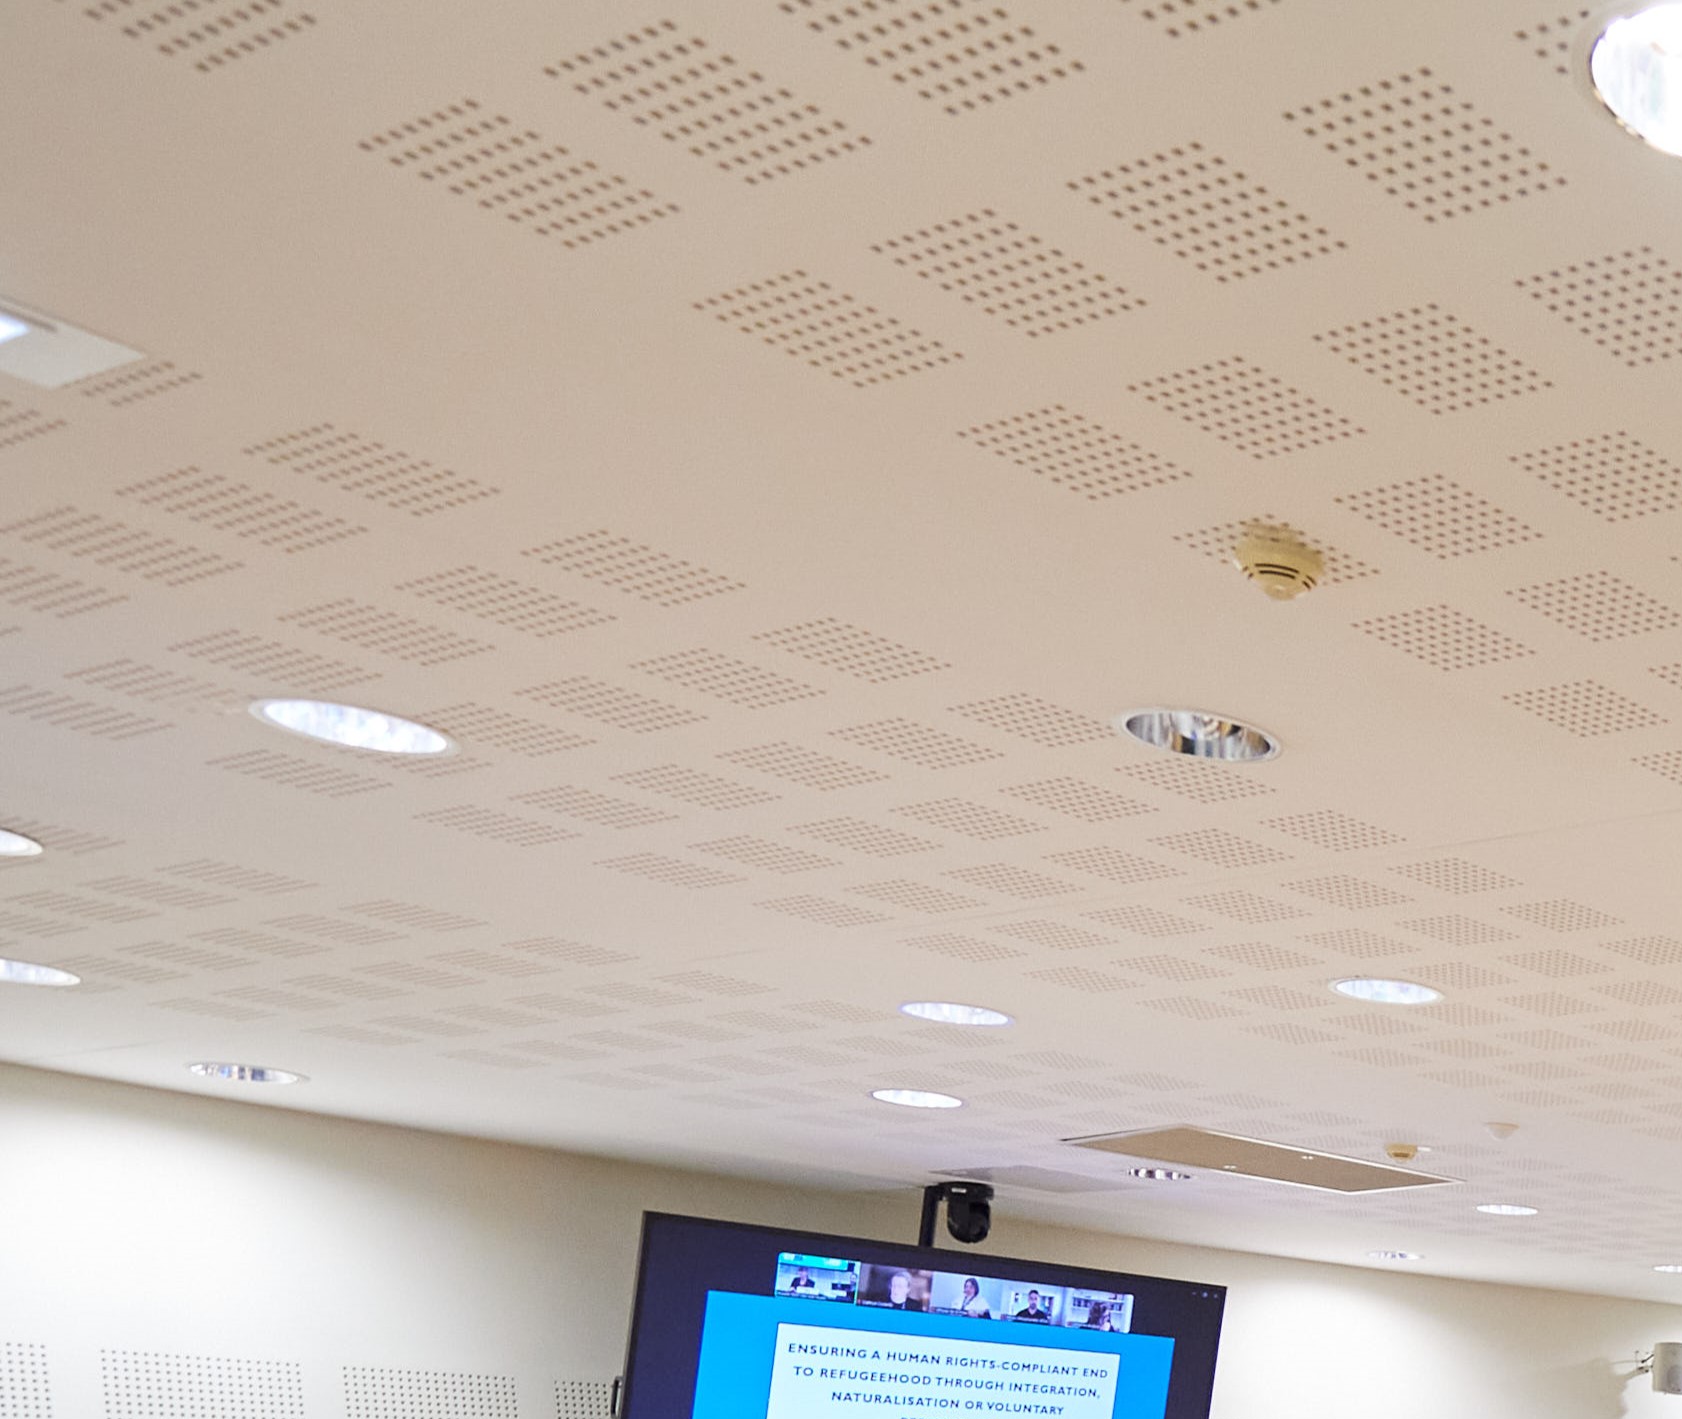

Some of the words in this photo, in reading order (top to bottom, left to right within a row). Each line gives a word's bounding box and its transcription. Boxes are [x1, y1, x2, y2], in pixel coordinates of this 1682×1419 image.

[788, 1343, 867, 1359] ENSURING
[871, 1350, 881, 1360] A
[886, 1351, 941, 1365] HUMAN
[945, 1356, 1079, 1376] RIGHTS-COMPLIANT
[1082, 1368, 1108, 1379] END
[793, 1366, 814, 1377] TO
[820, 1368, 932, 1385] REFUGEEHOOD
[935, 1377, 1005, 1391] THROUGH
[1008, 1382, 1101, 1399] INTEGRATION,
[831, 1391, 960, 1409] NATURALISATION
[964, 1400, 983, 1410] OR
[987, 1401, 1065, 1415] VOLUNTARY
